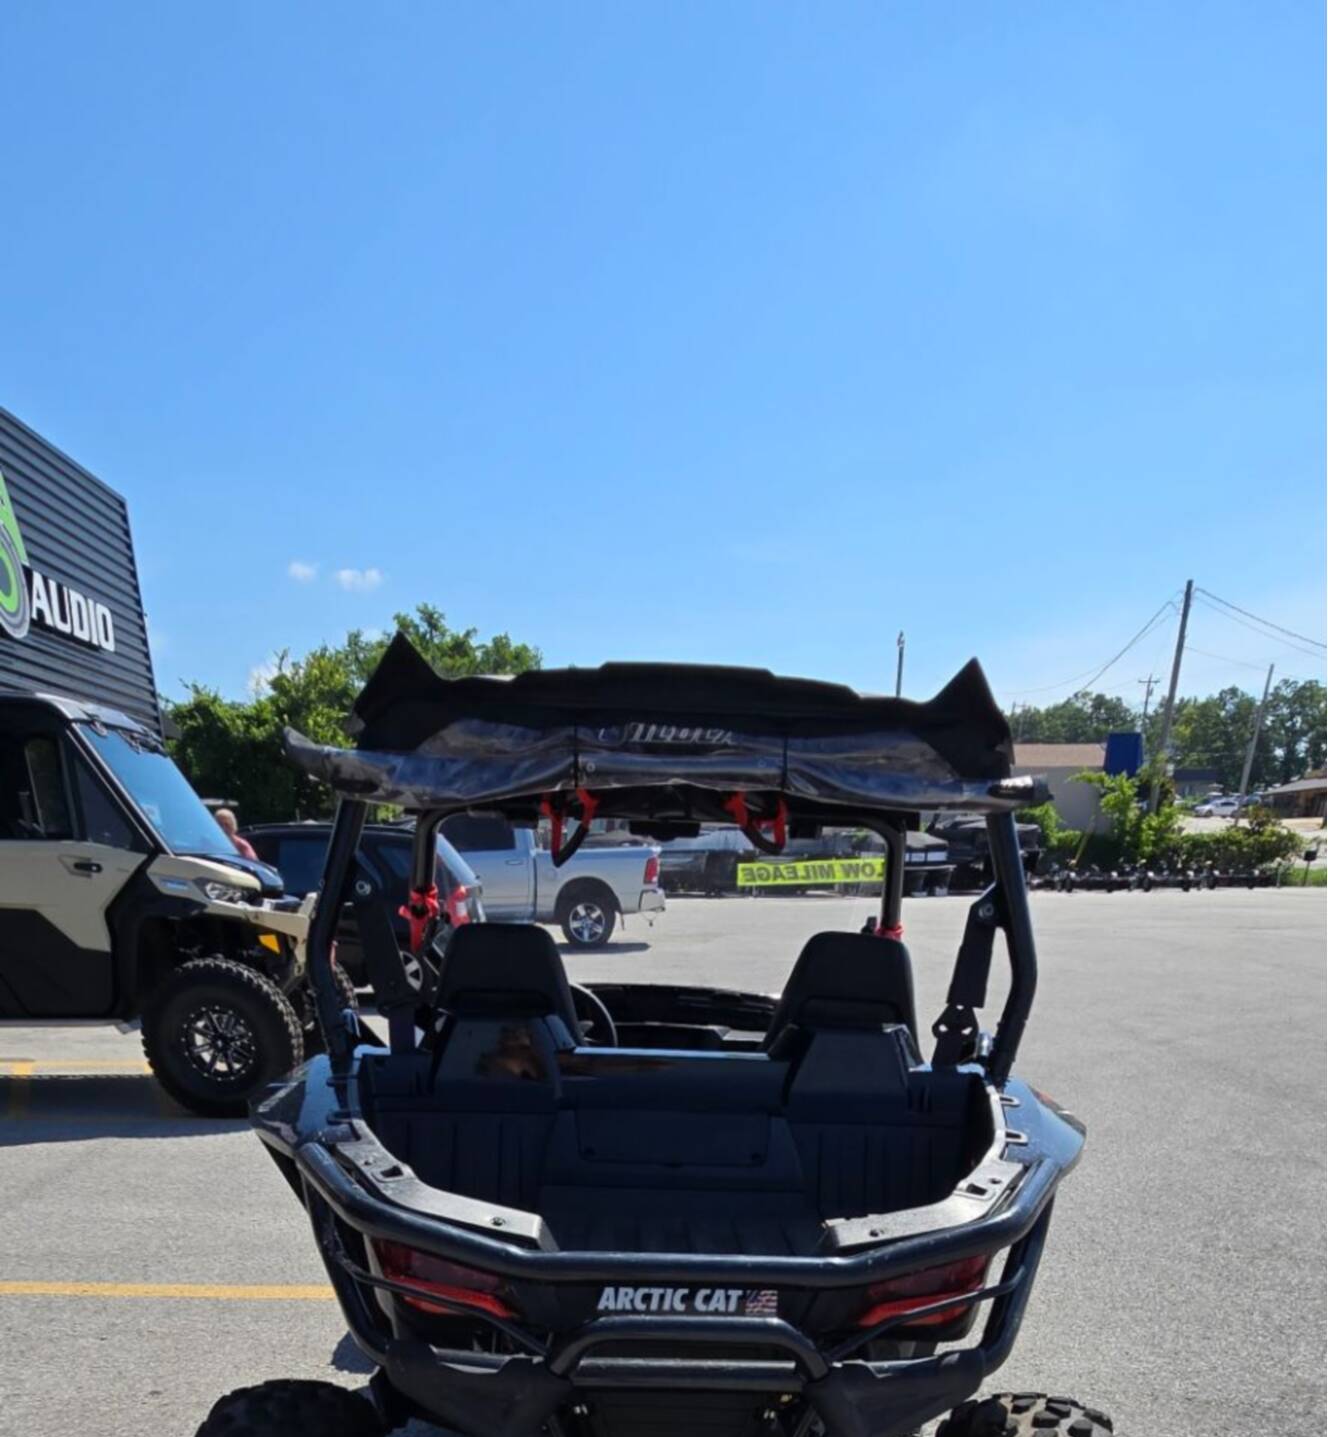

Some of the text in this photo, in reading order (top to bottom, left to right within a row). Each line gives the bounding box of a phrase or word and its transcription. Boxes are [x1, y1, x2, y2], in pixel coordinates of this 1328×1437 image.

[31, 569, 115, 652] AUDIO
[597, 1286, 743, 1313] ARCTIC CAT
